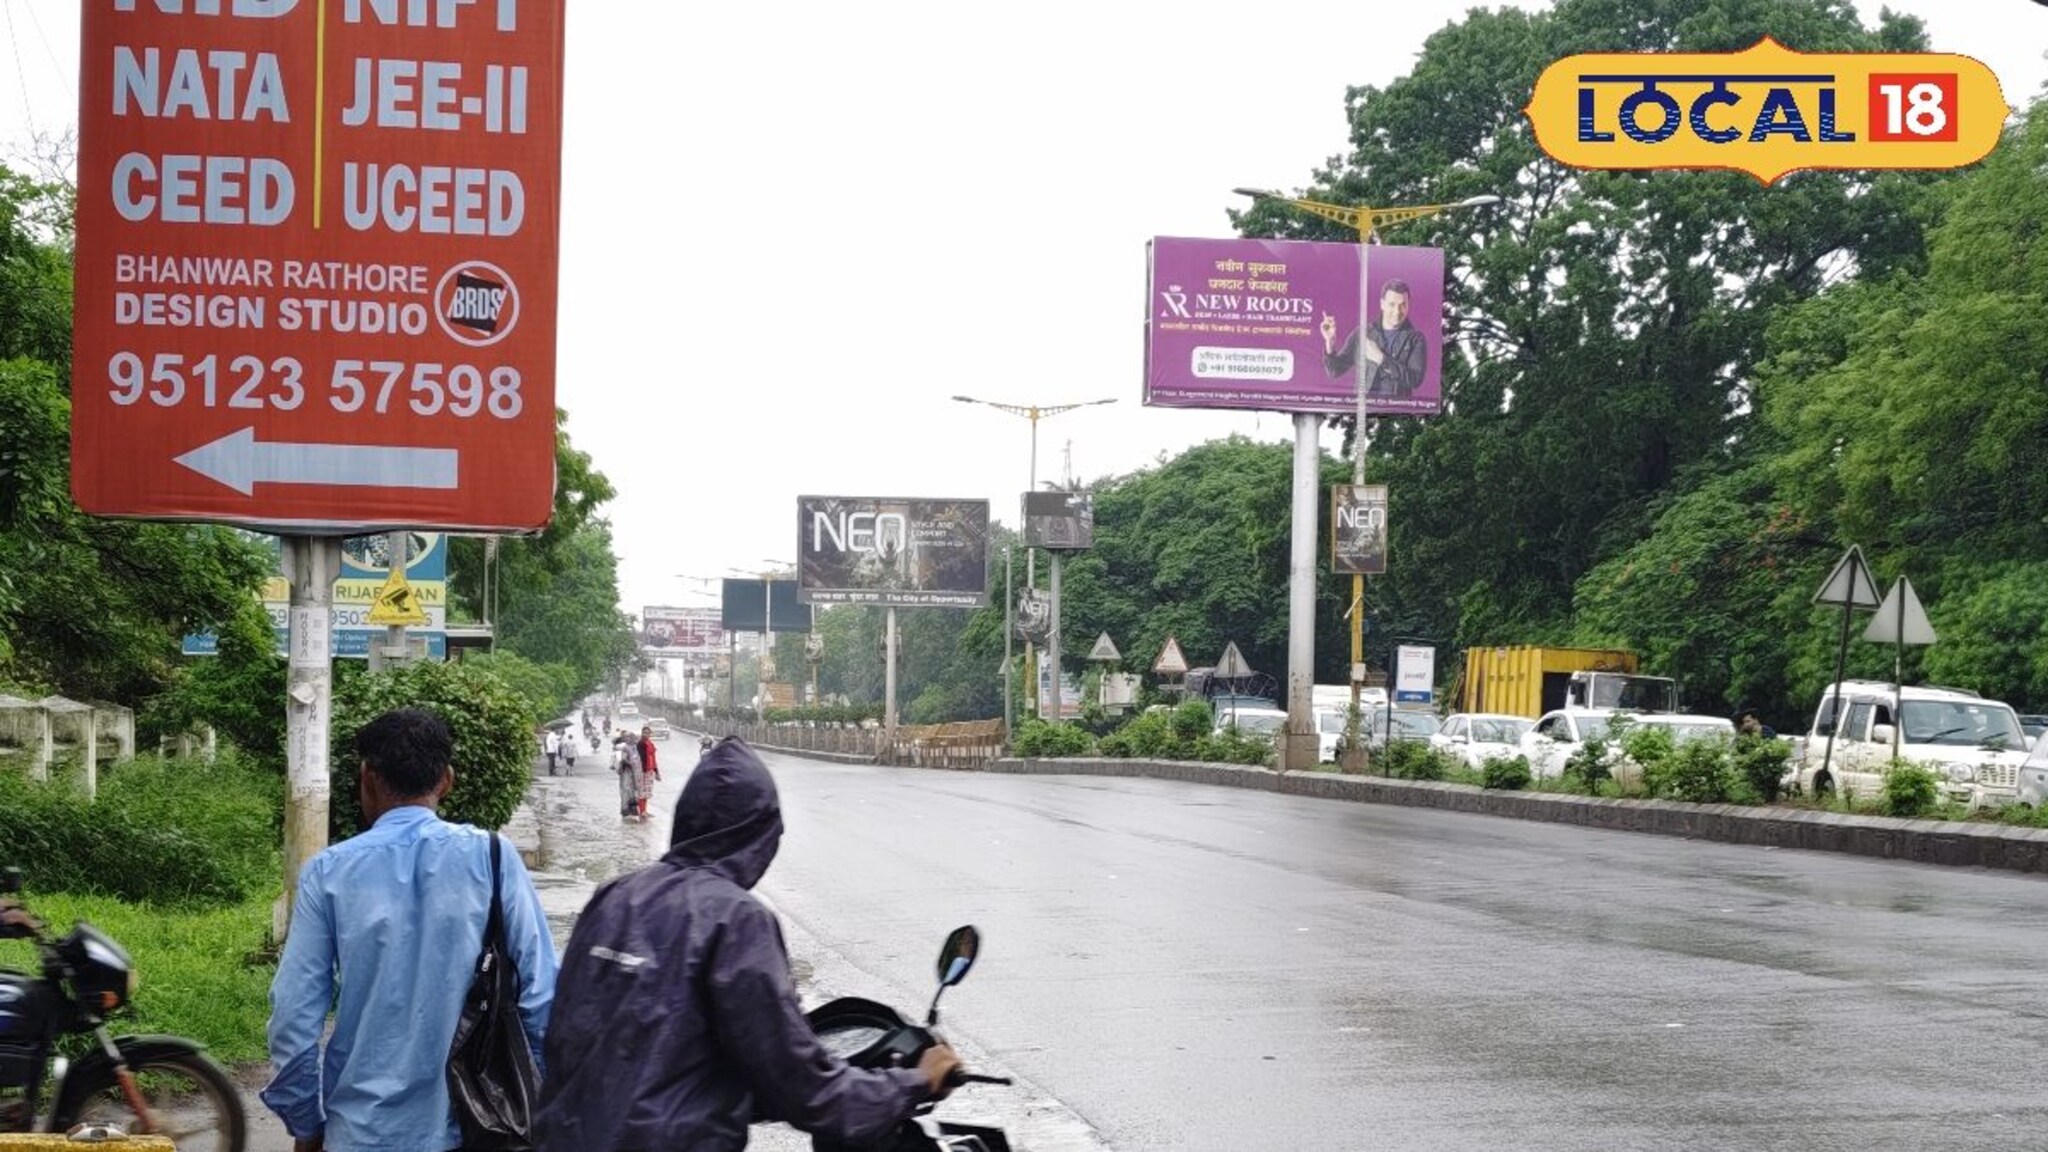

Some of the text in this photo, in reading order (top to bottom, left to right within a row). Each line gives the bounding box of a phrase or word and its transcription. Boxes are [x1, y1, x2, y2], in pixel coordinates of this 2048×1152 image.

[112, 45, 290, 123] NATA
[342, 57, 528, 134] JEE-II
[111, 151, 296, 226] CEED
[343, 162, 525, 237] UCEED
[115, 255, 429, 295] BHANWAR RATHORE
[115, 293, 428, 335] DESIGN STUDIO
[452, 286, 504, 321] BRDS
[1196, 294, 1313, 313] NEW ROOTS
[108, 351, 523, 419] 95123 57598
[814, 511, 905, 555] NEO
[1337, 506, 1384, 529] NEO
